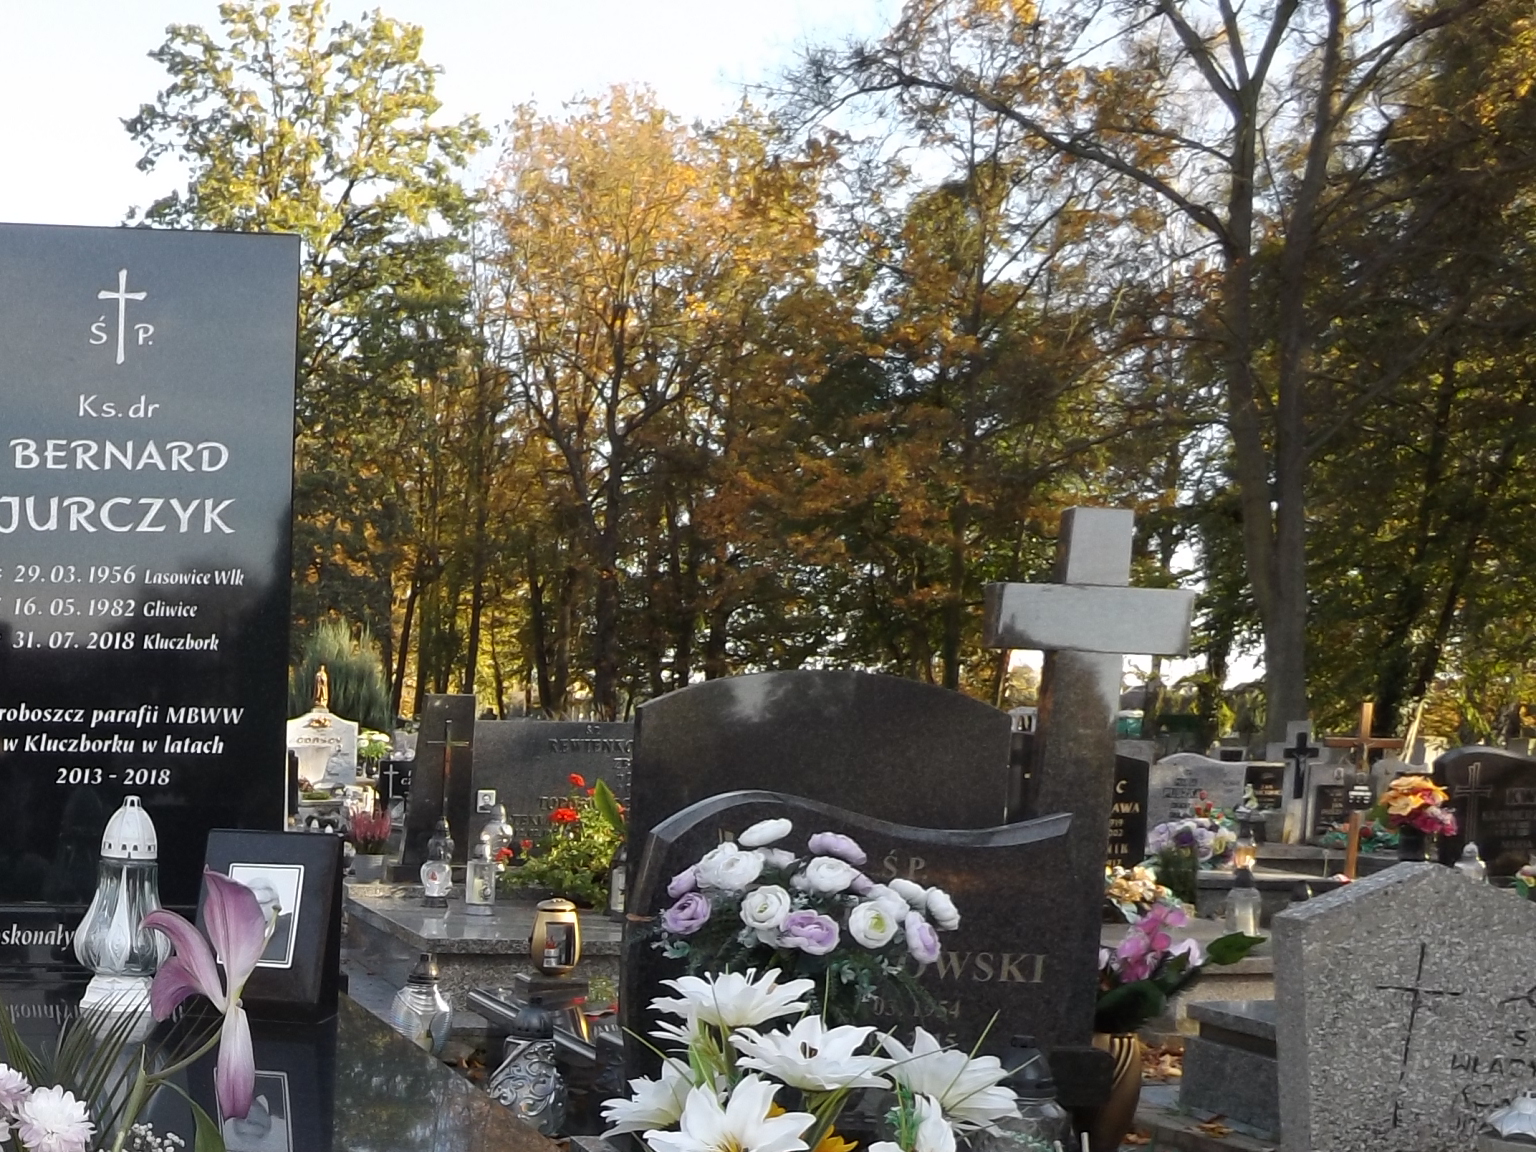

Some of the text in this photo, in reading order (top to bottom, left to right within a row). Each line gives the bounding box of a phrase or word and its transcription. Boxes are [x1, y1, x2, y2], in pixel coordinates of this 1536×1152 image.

[89, 316, 107, 345] Ś
[78, 394, 160, 418] Ks. dr
[9, 438, 229, 472] BERNARD
[144, 569, 211, 585] Lasowice
[214, 569, 245, 586] Wlk
[143, 601, 198, 617] Gliwice
[143, 634, 220, 651] Kluczbork
[90, 704, 159, 728] parafii
[165, 706, 245, 724] MBWW
[2, 733, 224, 755] w Kluczborku w latach
[55, 767, 103, 784] 2013
[123, 768, 171, 785] 2018
